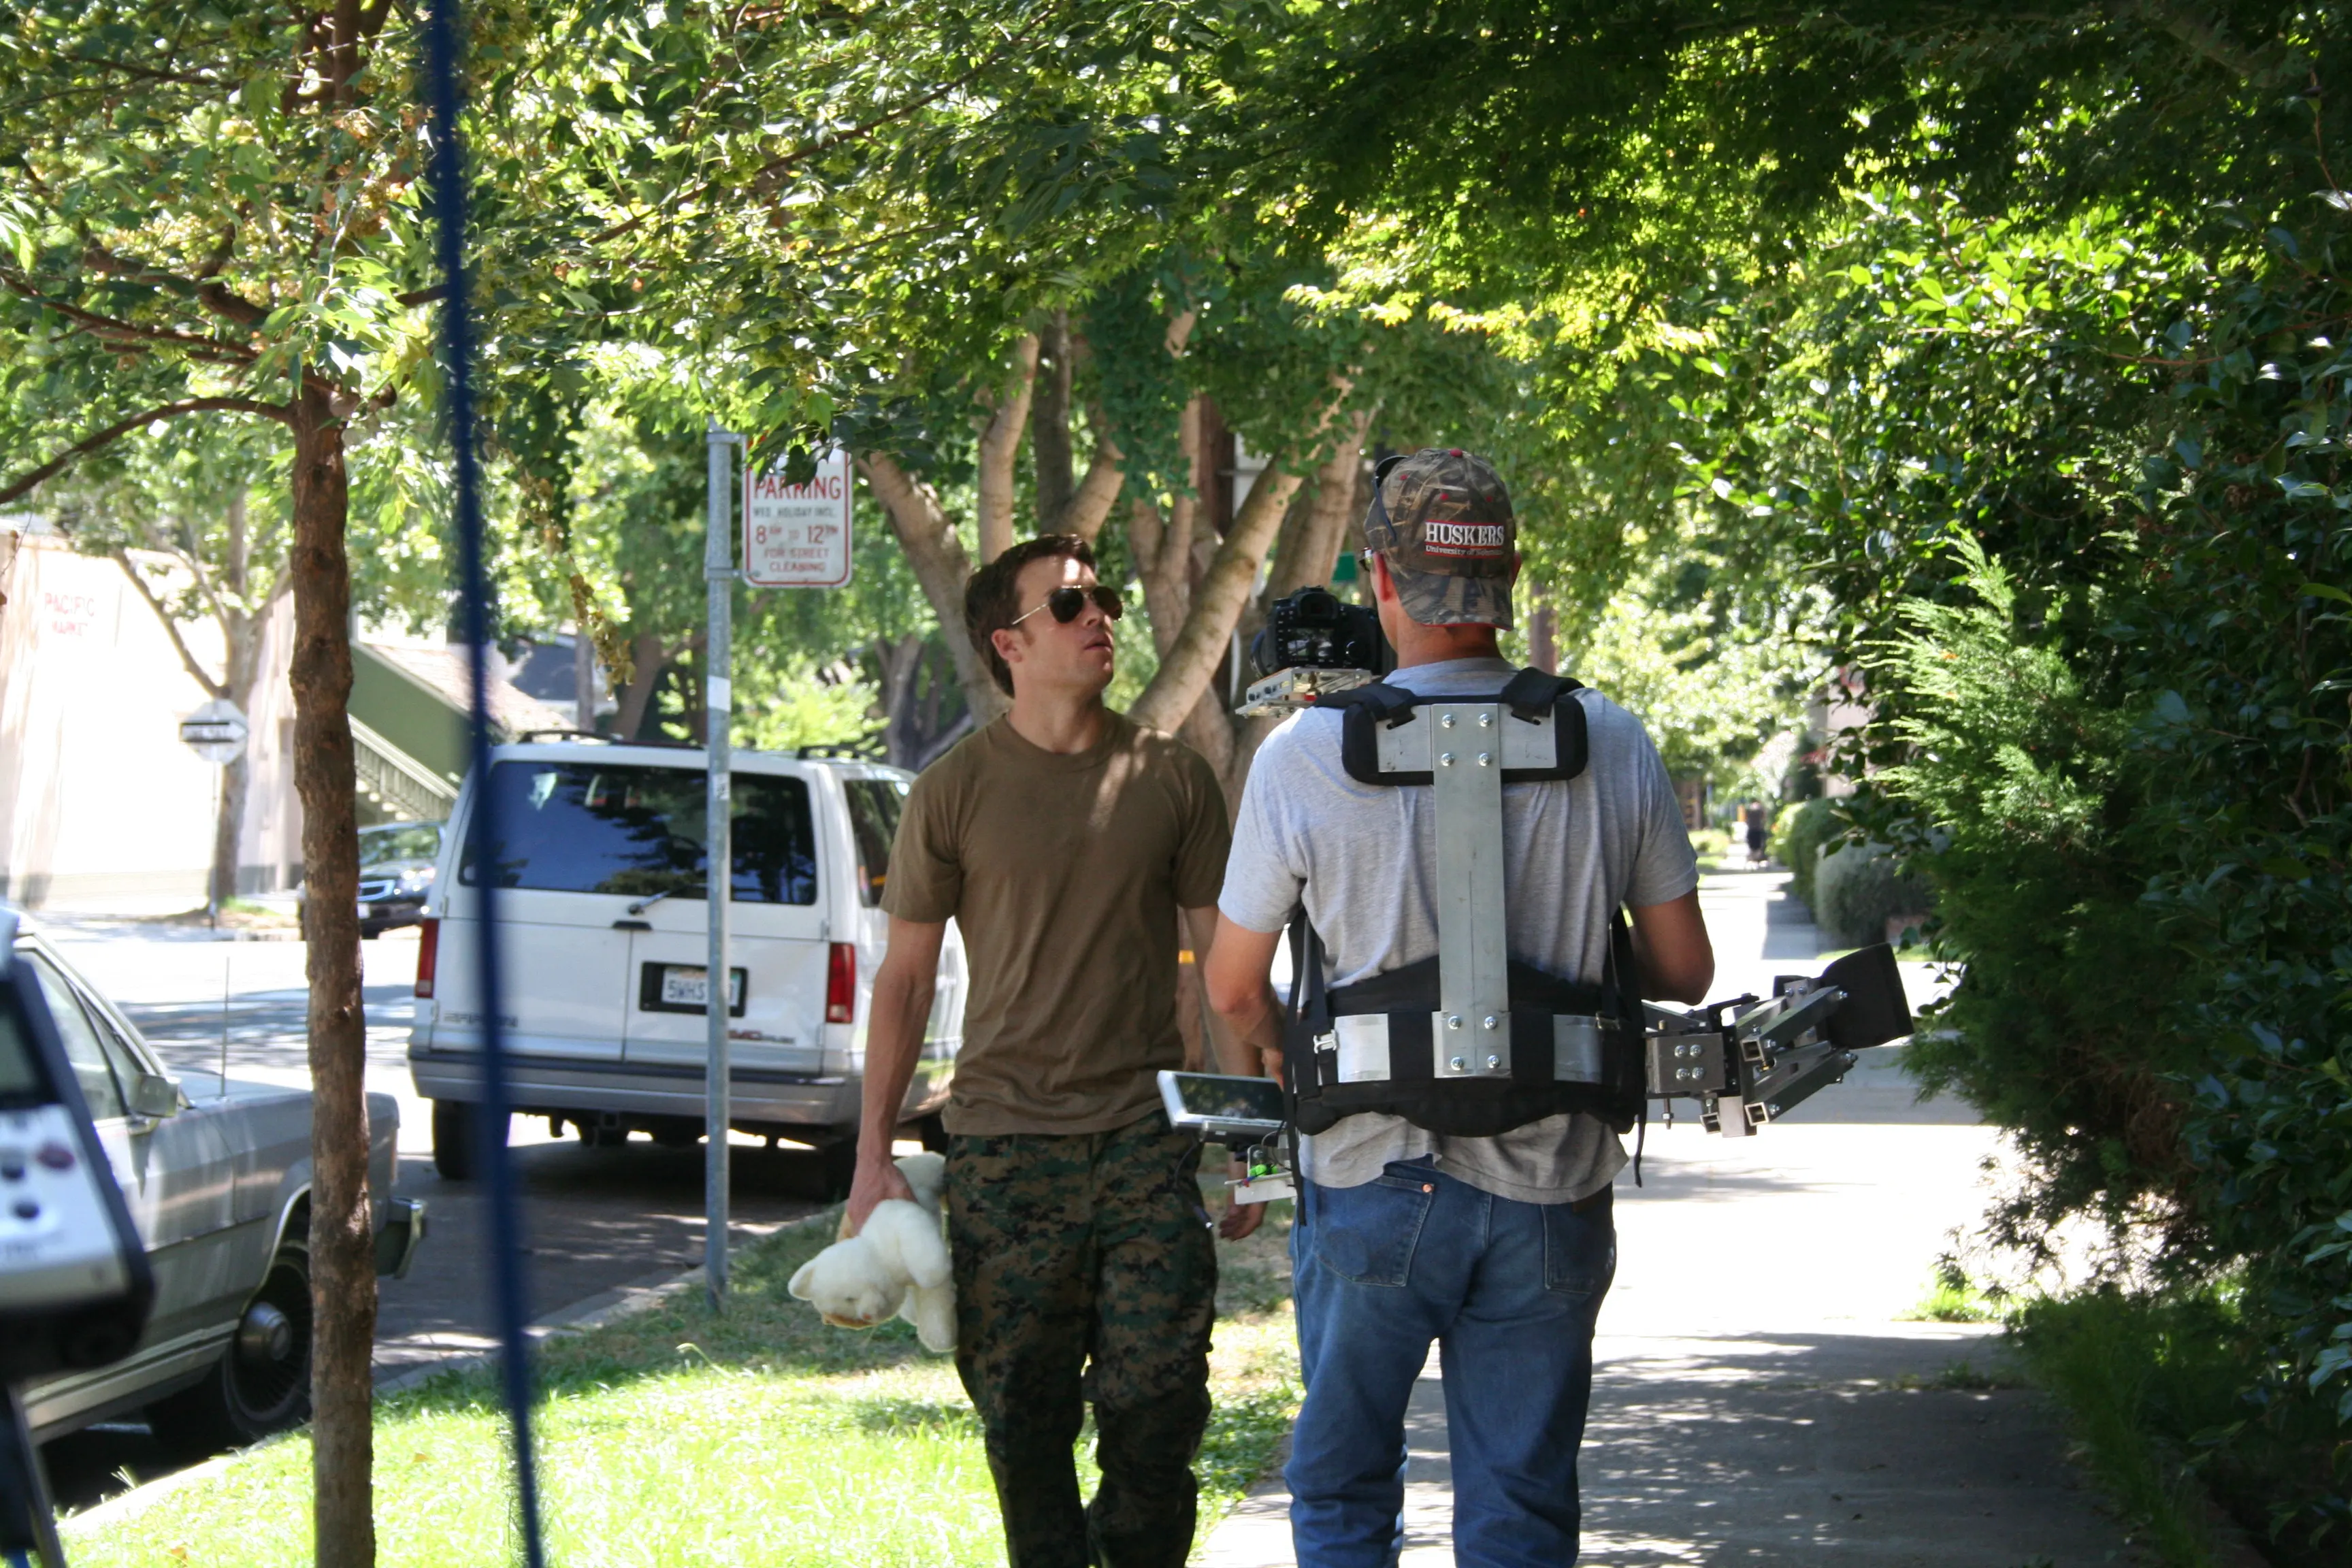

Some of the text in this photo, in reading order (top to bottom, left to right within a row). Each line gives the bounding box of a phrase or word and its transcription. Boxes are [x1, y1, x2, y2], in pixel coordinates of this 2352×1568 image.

[1424, 522, 1505, 546] HUSKERS
[789, 549, 829, 559] STREET
[1426, 546, 1465, 556] University
[769, 561, 826, 572] CLEANING
